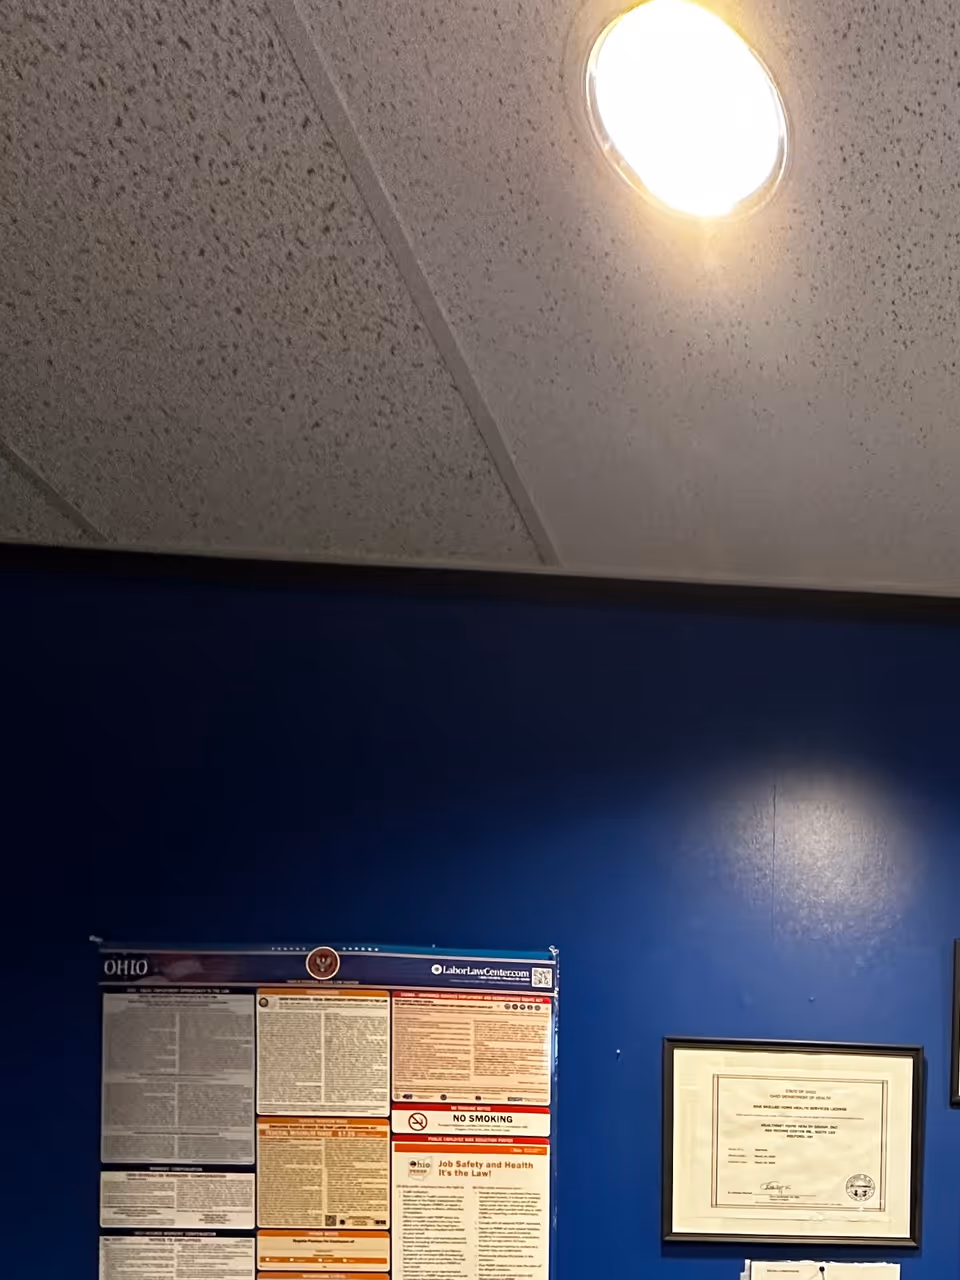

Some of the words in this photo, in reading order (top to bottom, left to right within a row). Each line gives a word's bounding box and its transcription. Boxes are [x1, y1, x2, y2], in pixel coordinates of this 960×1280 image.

[104, 960, 148, 975] OHIO
[443, 966, 530, 978] LaborLawCenter.com
[453, 1114, 465, 1122] NO
[469, 1115, 513, 1123] SMOKING
[456, 1160, 483, 1170] Safety
